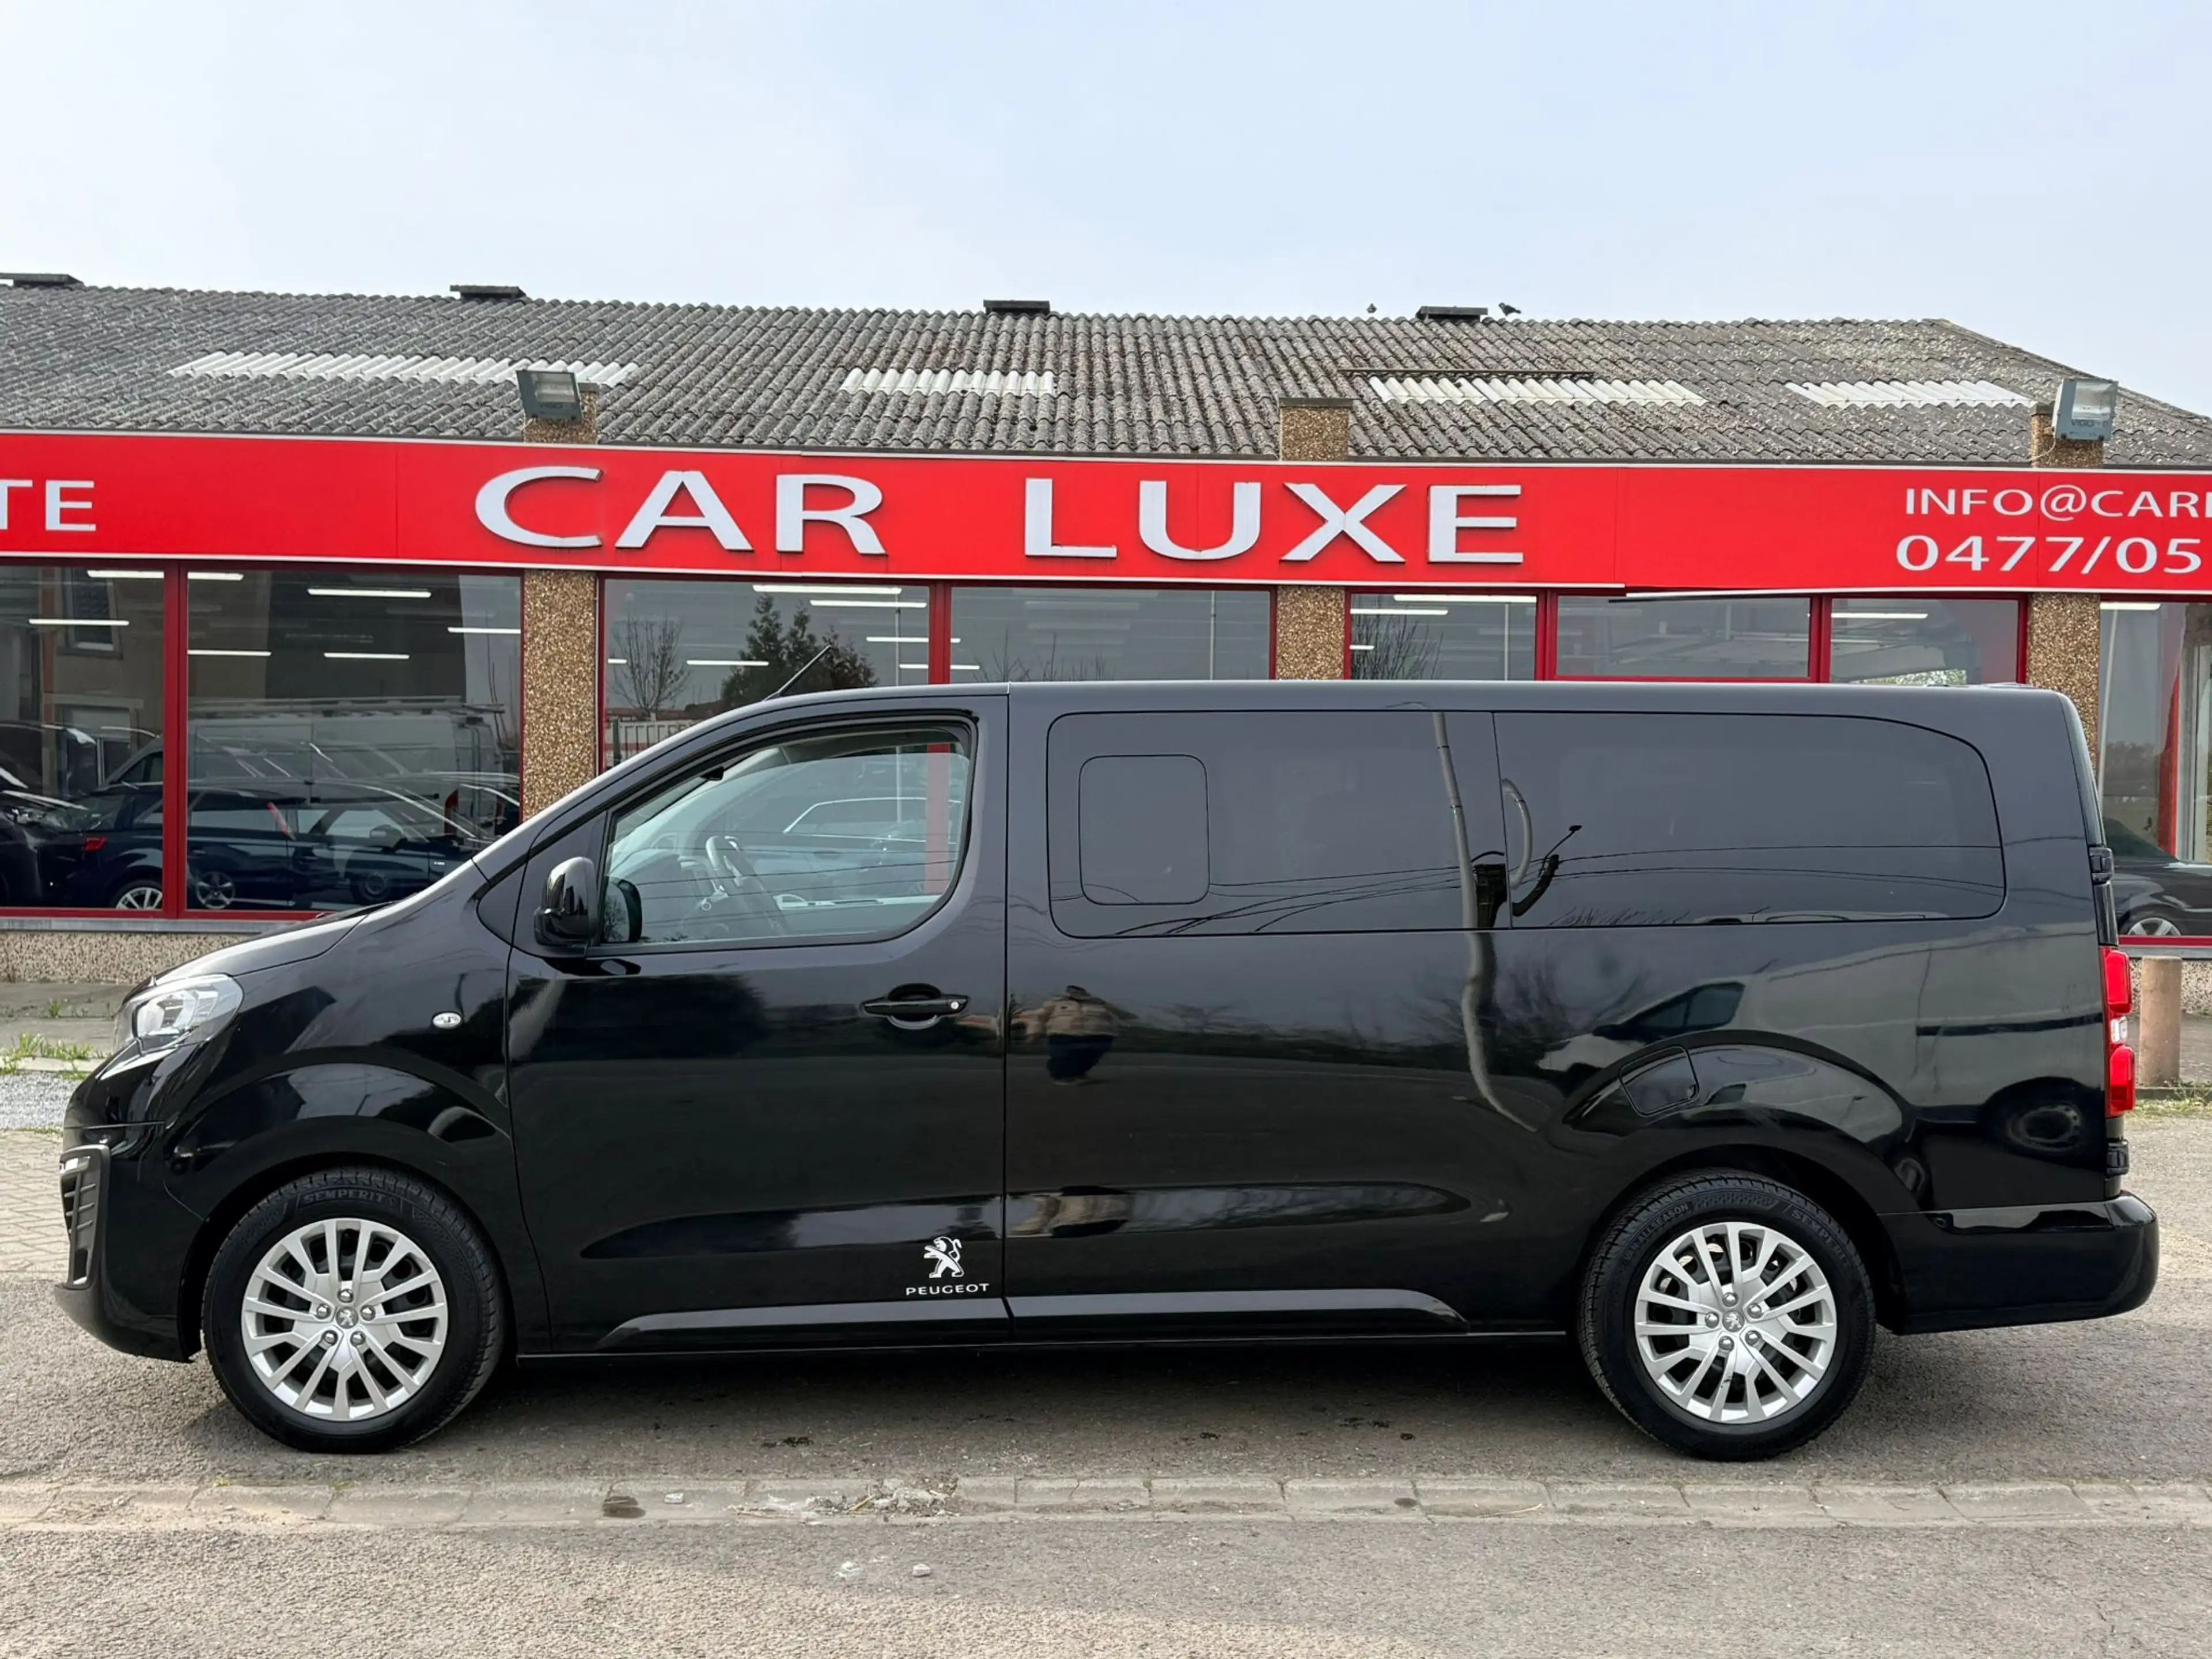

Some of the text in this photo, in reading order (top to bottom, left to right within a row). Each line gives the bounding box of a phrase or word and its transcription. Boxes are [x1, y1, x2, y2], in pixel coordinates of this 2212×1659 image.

[475, 465, 1524, 563] CAR LUXE
[1906, 484, 2212, 521] INFO@CAR
[1896, 535, 2201, 574] 0477/05
[303, 1188, 387, 1203] SEMPERIT
[906, 1283, 990, 1296] PEUGEOT
